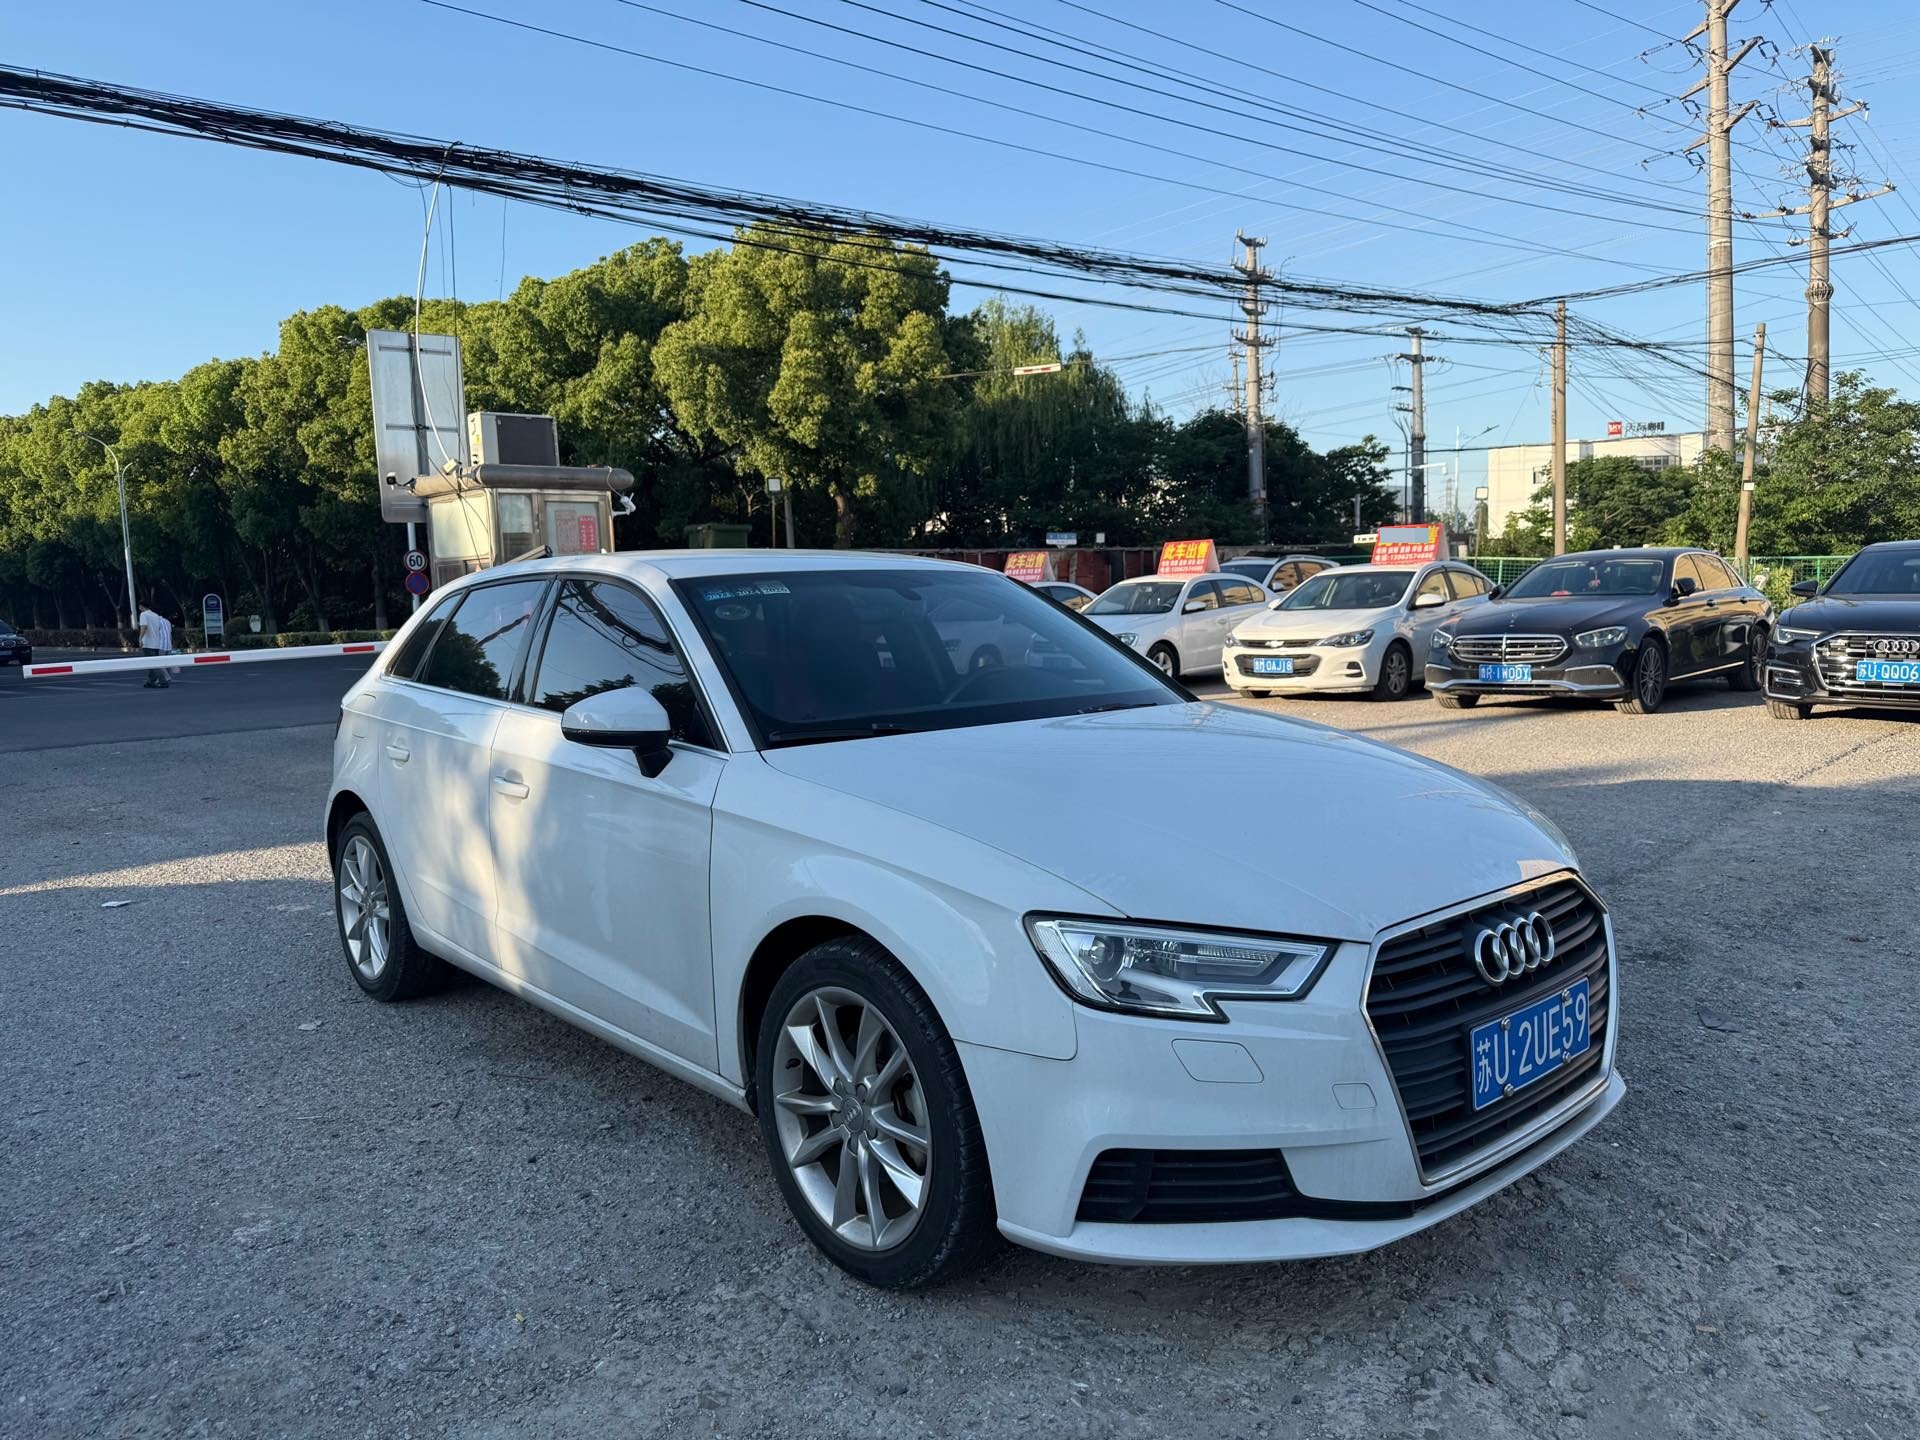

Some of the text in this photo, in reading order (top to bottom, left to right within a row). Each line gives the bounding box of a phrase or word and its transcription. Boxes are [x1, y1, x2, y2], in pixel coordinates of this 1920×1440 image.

[1163, 541, 1209, 560] 此车出售
[409, 555, 423, 567] 60
[1006, 552, 1046, 569] 此车出售
[1476, 991, 1587, 1095] 苏U·2UE59
